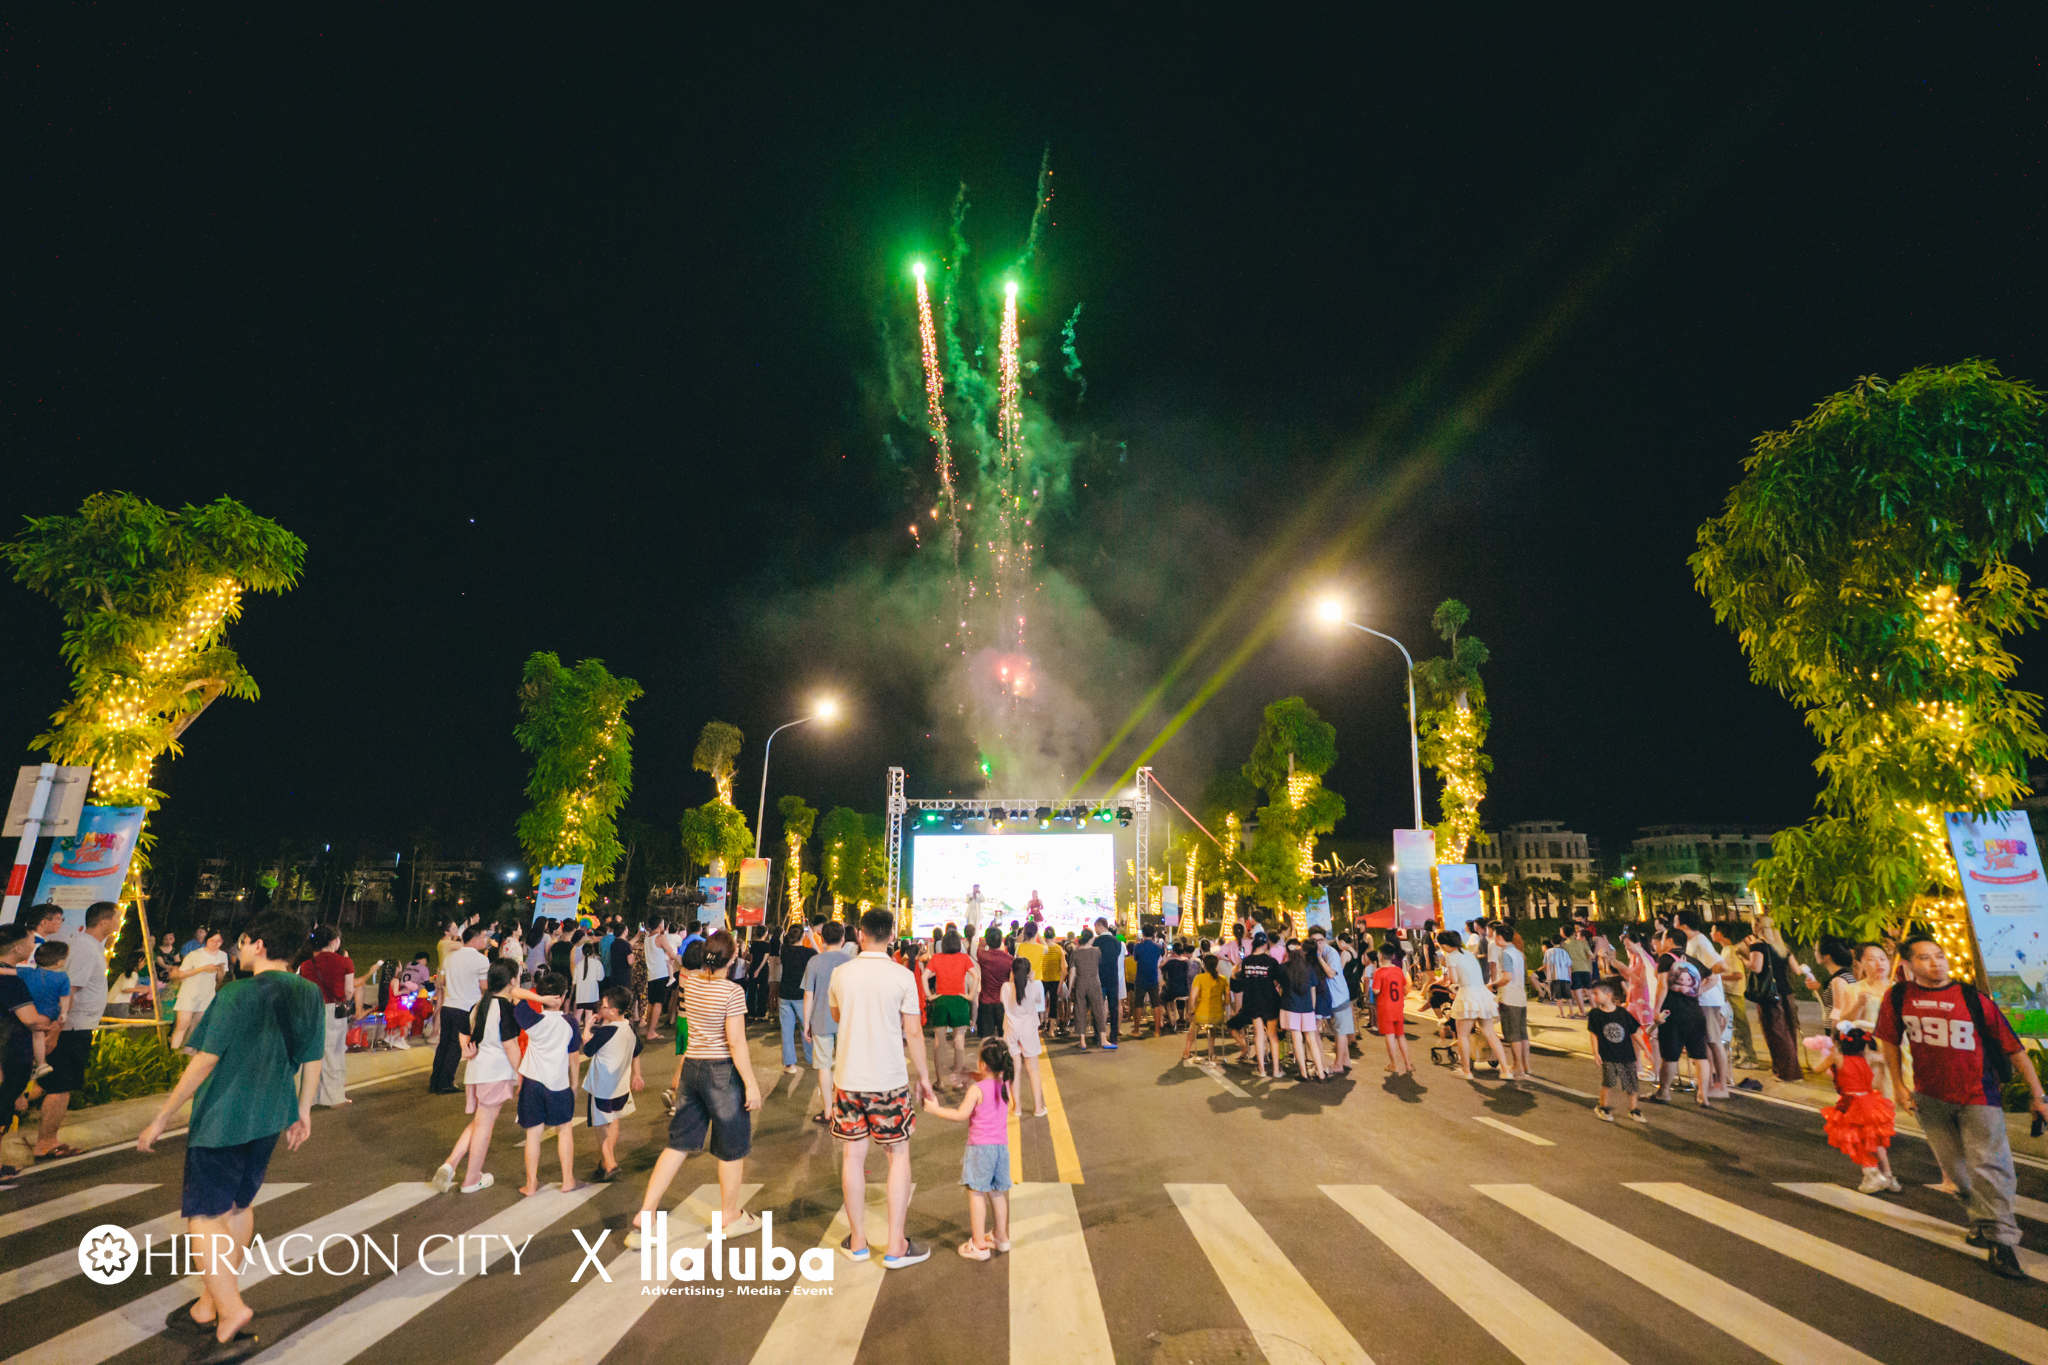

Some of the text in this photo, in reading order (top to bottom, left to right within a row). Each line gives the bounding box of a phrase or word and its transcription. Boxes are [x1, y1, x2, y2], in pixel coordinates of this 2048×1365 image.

[1962, 838, 2028, 857] SUMMER
[976, 850, 1049, 867] SUMER
[1389, 981, 1399, 1002] 6
[1902, 1014, 1976, 1051] 898
